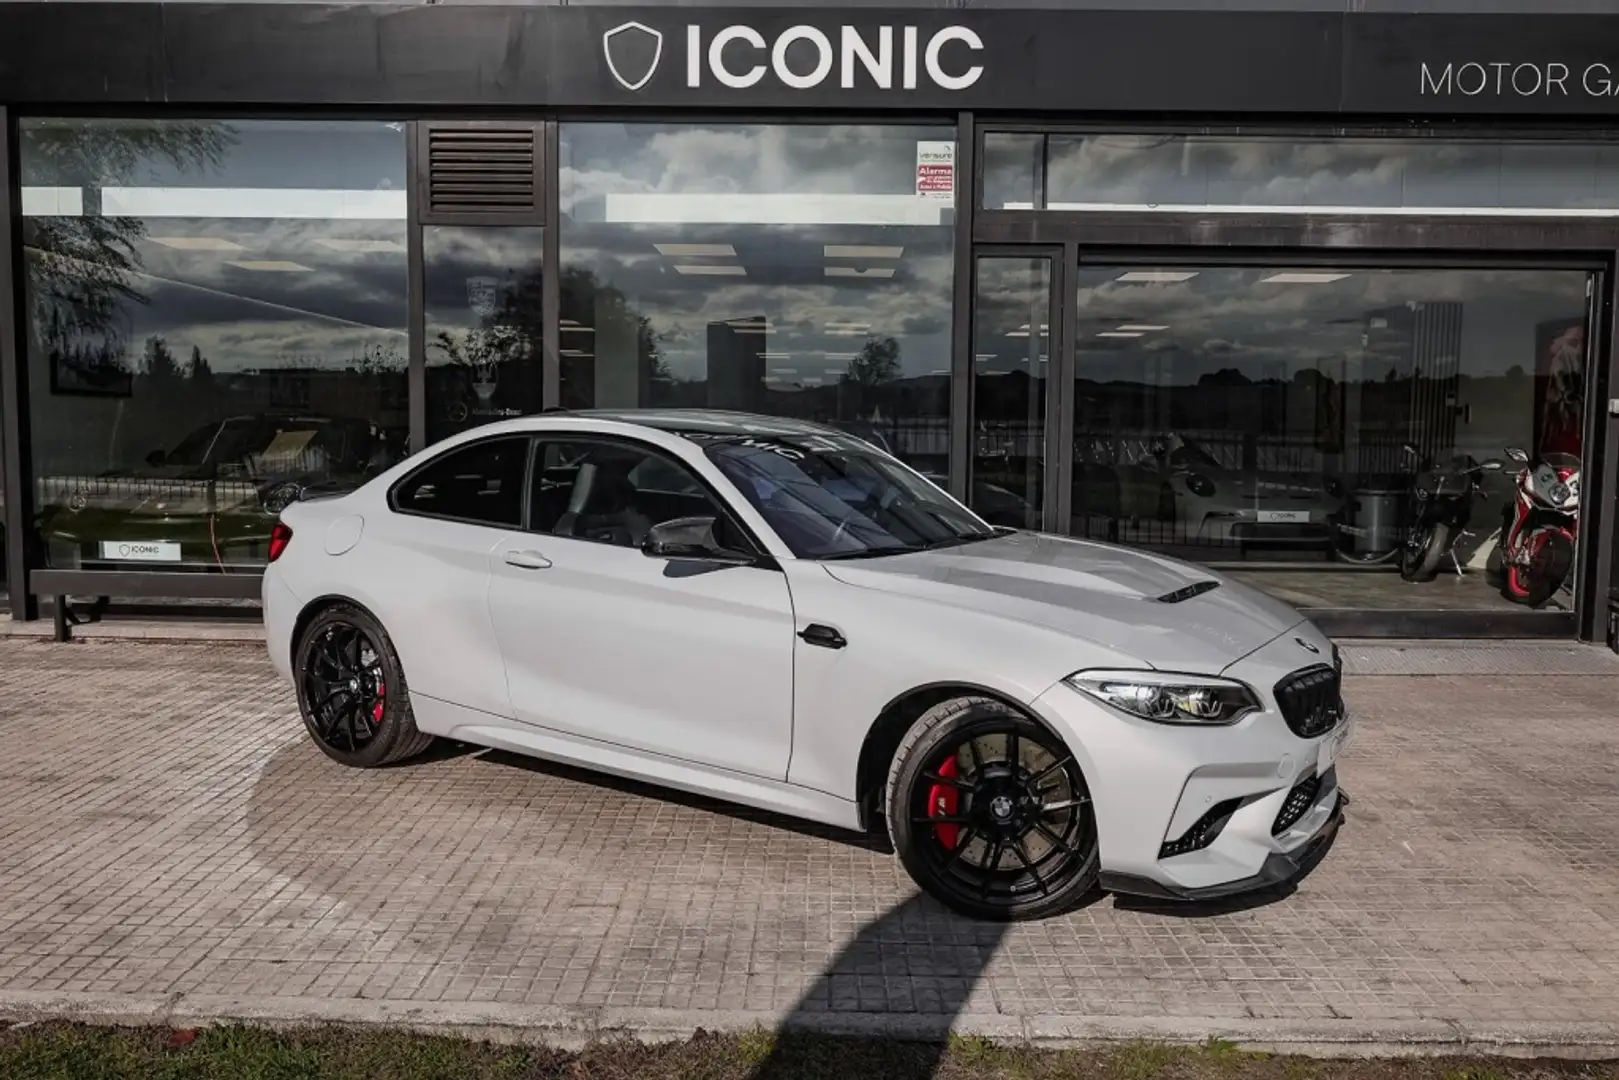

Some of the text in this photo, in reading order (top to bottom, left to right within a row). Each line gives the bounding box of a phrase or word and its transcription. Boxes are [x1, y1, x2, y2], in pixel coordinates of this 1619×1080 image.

[687, 24, 984, 89] ICONIC
[1420, 62, 1619, 96] MOTOR G
